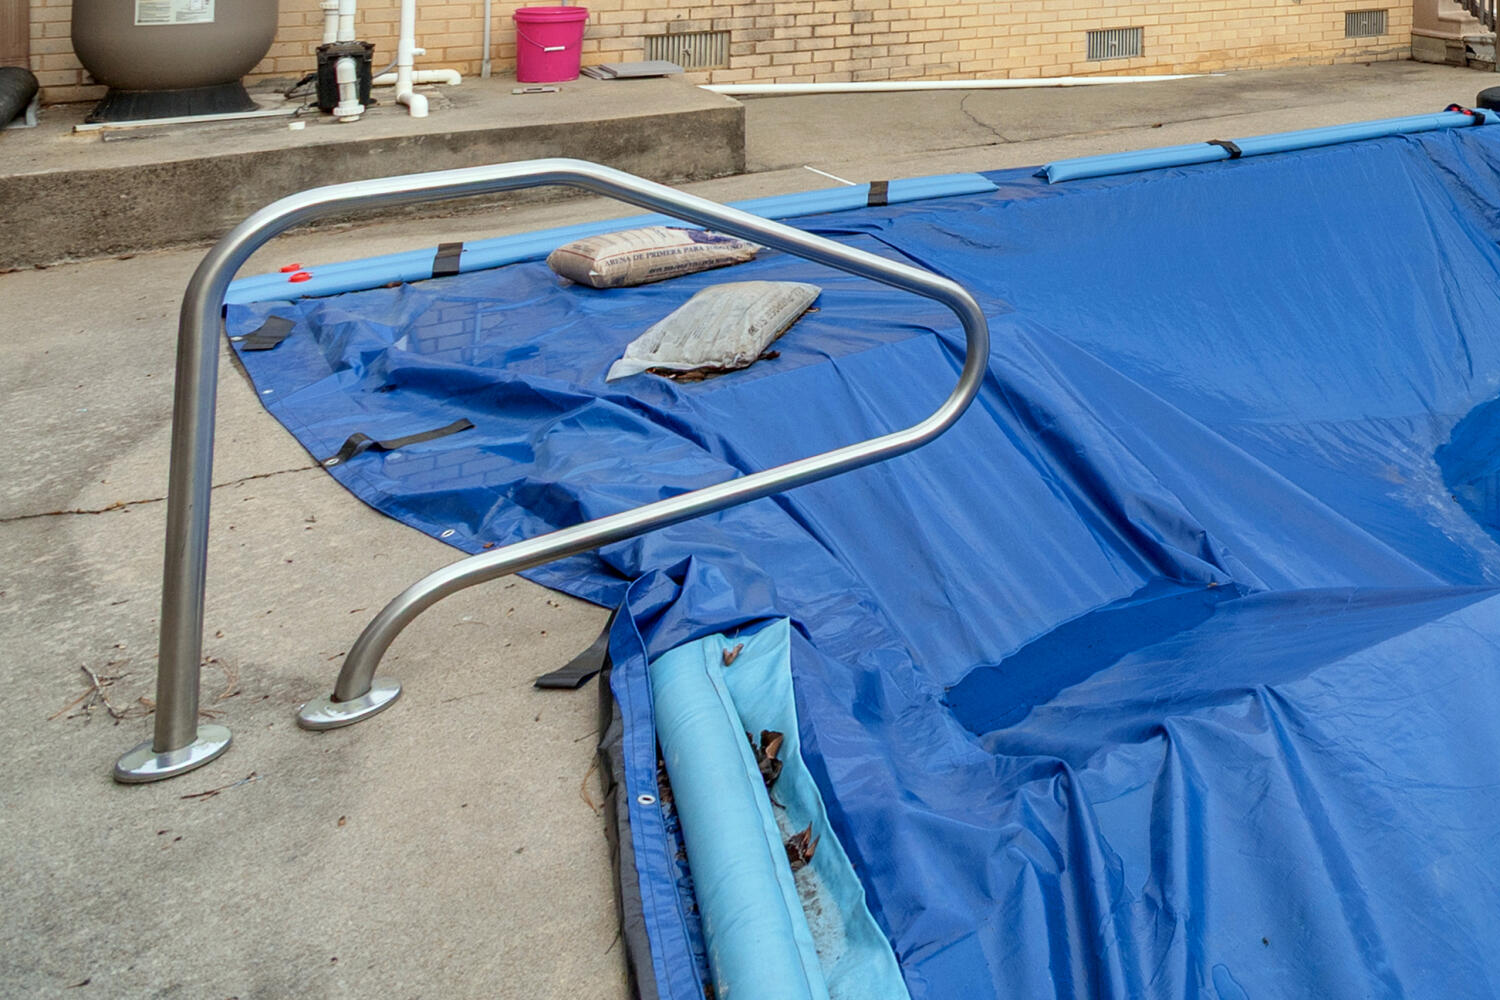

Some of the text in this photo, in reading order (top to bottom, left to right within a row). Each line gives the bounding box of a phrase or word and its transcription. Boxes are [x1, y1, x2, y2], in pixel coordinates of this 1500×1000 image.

[605, 255, 632, 266] ARENA
[633, 253, 643, 261] DE
[647, 248, 682, 259] PRIMERA
[683, 245, 704, 255] PARA
